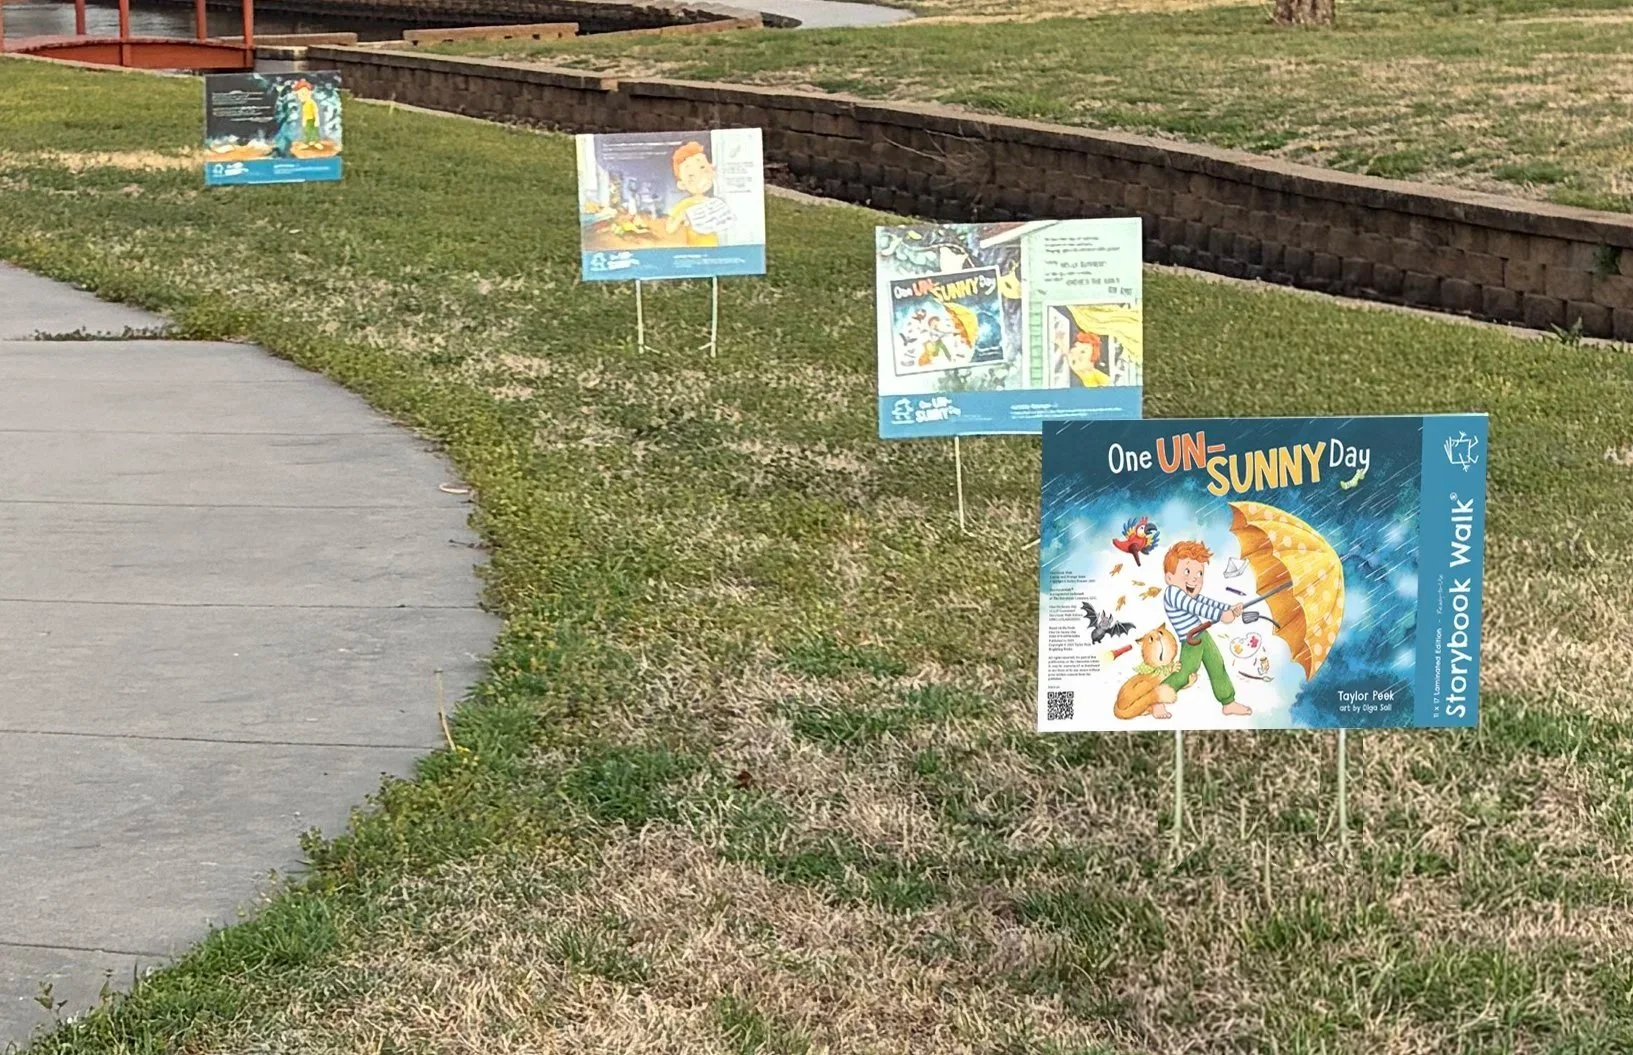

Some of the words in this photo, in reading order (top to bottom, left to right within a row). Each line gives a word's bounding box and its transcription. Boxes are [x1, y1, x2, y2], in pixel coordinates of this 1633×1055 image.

[931, 276, 979, 303] SUNNY
[1108, 442, 1153, 474] One
[1156, 430, 1226, 474] UN-
[1206, 440, 1327, 497] SUNNY
[1329, 437, 1371, 479] Day
[1434, 627, 1443, 654] Edition
[1445, 577, 1473, 719] Storybook
[1433, 655, 1442, 696] Laminated
[1337, 690, 1369, 705] Taylor
[1372, 689, 1394, 701] Peek
[1339, 704, 1351, 712] art
[1352, 704, 1361, 714] by
[1362, 704, 1378, 714] Olga
